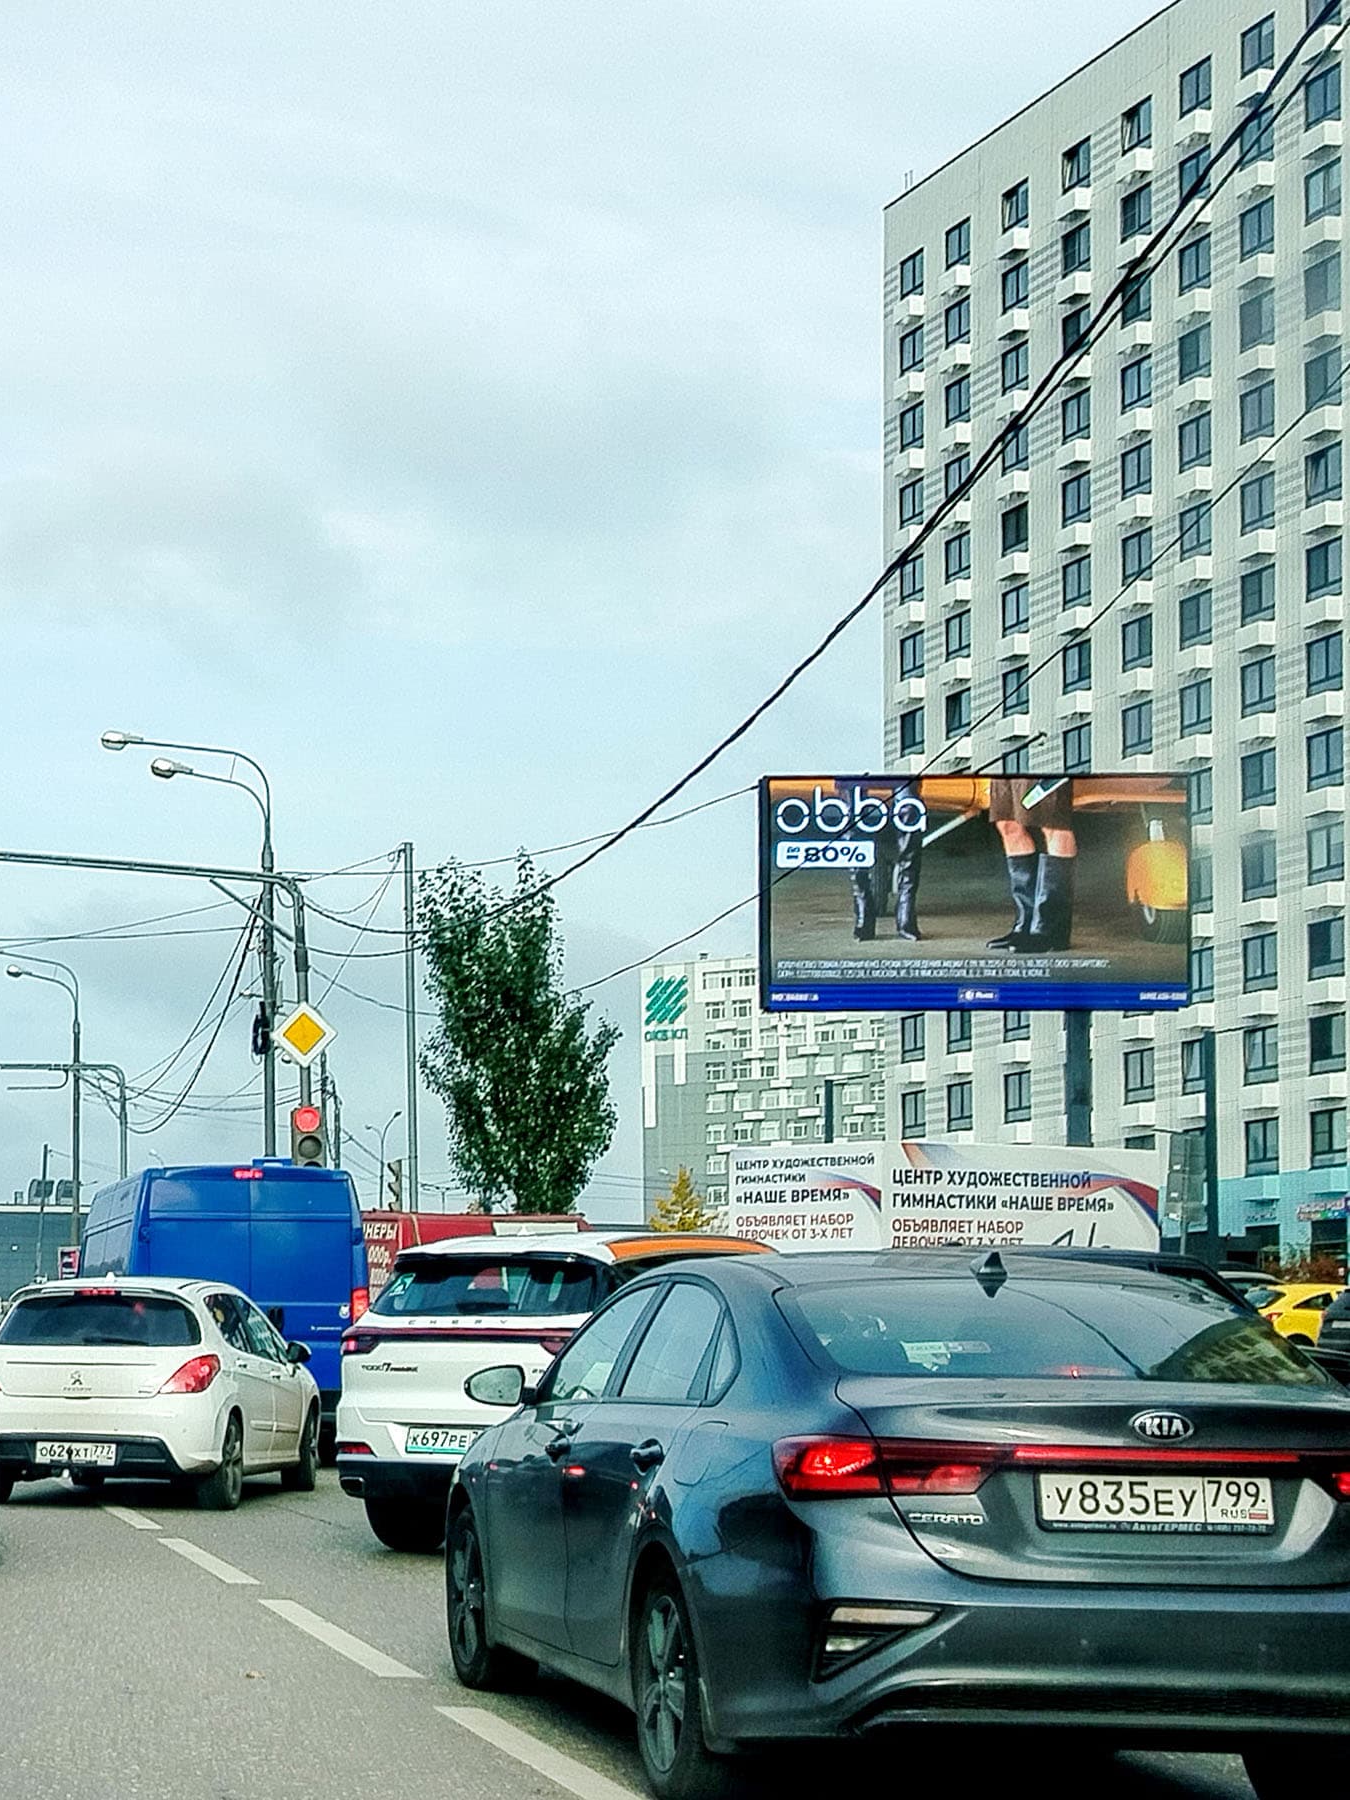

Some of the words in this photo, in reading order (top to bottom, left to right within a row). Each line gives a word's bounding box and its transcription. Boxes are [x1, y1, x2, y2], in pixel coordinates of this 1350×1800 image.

[776, 785, 927, 834] obba
[735, 1158, 769, 1170] ЦЕНТР
[771, 1152, 875, 1170] ХУДОЖЕСТВЕННОЙ
[735, 1173, 806, 1185] ГИМНАСТИКИ
[892, 1169, 943, 1185] ЦЕНТР
[947, 1170, 1091, 1188] ХУДОЖЕСТВЕННОЙ
[892, 1193, 997, 1209] ГИМНАСТИКИ
[1001, 1196, 1053, 1211] «НАШЕ
[1057, 1197, 1114, 1212] ВРЕМЯ»
[736, 1214, 807, 1227] ОБЪЯВЛЯЕТ
[810, 1213, 854, 1225] НАБОР
[892, 1218, 973, 1233] ОБЪЯВЛЯЕТ
[977, 1221, 1024, 1234] НАБОР
[791, 1228, 807, 1239] ОТ
[810, 1228, 828, 1239] 3-Х
[831, 1227, 854, 1239] ЛЕТ
[1144, 1417, 1186, 1437] KIA
[410, 1430, 467, 1448] К697РЕ
[1054, 1480, 1197, 1518] У835ЕУ
[1206, 1479, 1261, 1509] 799
[908, 1512, 984, 1526] CERATO
[1220, 1509, 1248, 1520] RUS
